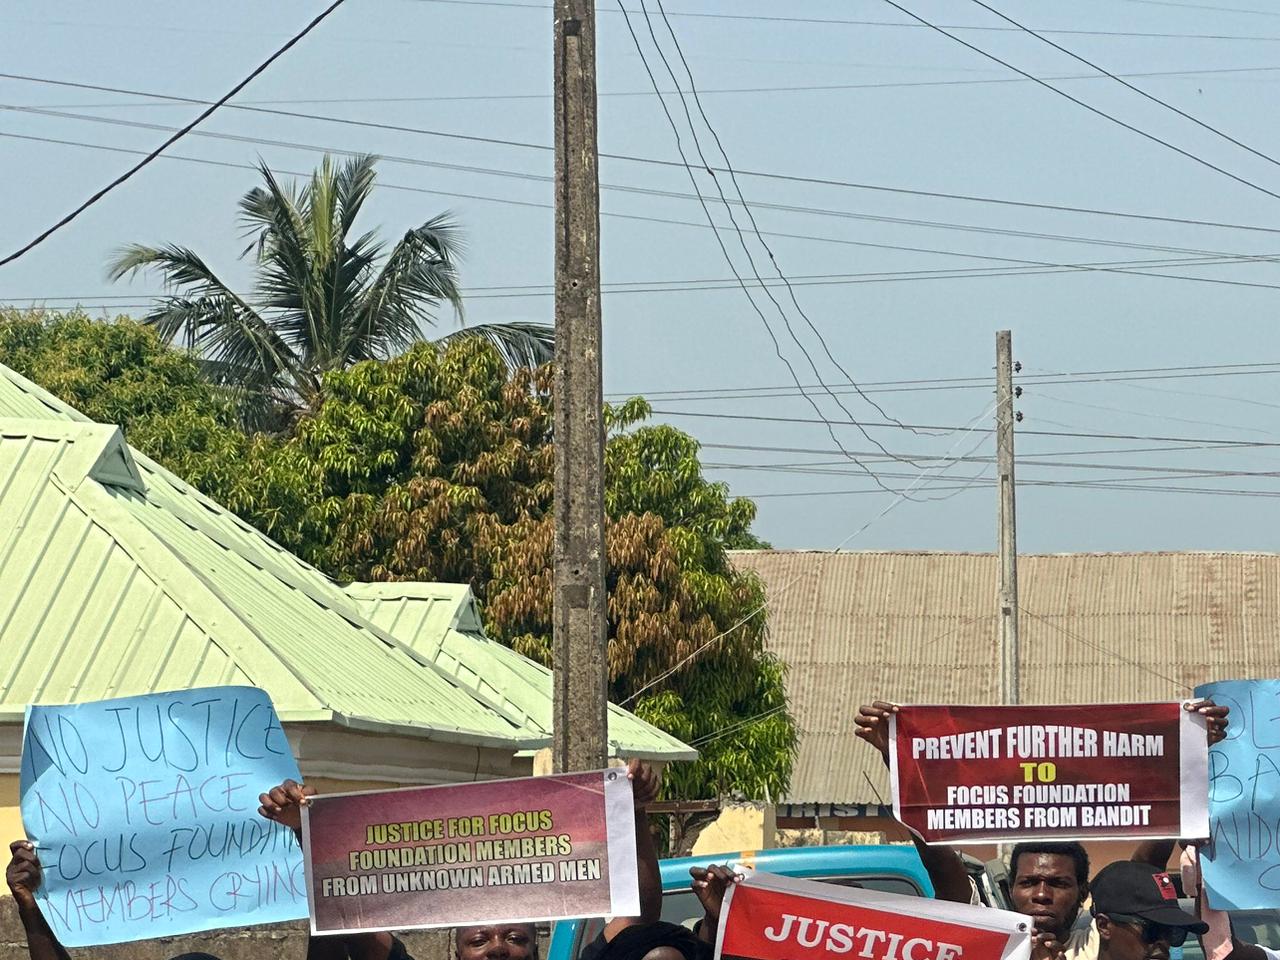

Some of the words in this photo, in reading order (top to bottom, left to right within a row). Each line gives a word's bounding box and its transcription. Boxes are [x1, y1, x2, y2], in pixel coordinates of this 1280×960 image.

[27, 714, 88, 781] NO
[102, 698, 285, 772] JUSTICE
[912, 728, 1002, 760] PREVENT
[1006, 725, 1098, 759] FURTHER
[1102, 734, 1164, 757] HARM
[1019, 762, 1057, 783] TO
[35, 782, 100, 836] NO
[115, 772, 253, 825] PEACE
[947, 785, 1009, 806] FOCUS
[1013, 783, 1130, 805] FOUNDATION
[365, 819, 444, 845] JUSTICE
[448, 816, 485, 838] FOR
[489, 809, 553, 835] FOCUS
[926, 807, 1020, 830] MEMBERS
[1024, 807, 1078, 828] FROM
[1081, 805, 1151, 827] BANDIT
[34, 832, 147, 881] FOCUS
[349, 844, 472, 871] FOUNDATION
[476, 834, 572, 862] MEMBERS
[321, 874, 378, 898] FROM
[382, 867, 484, 893] UNKNOWN
[487, 862, 556, 887] ARMED
[560, 858, 601, 882] MEN
[46, 874, 198, 932] MEMBERS
